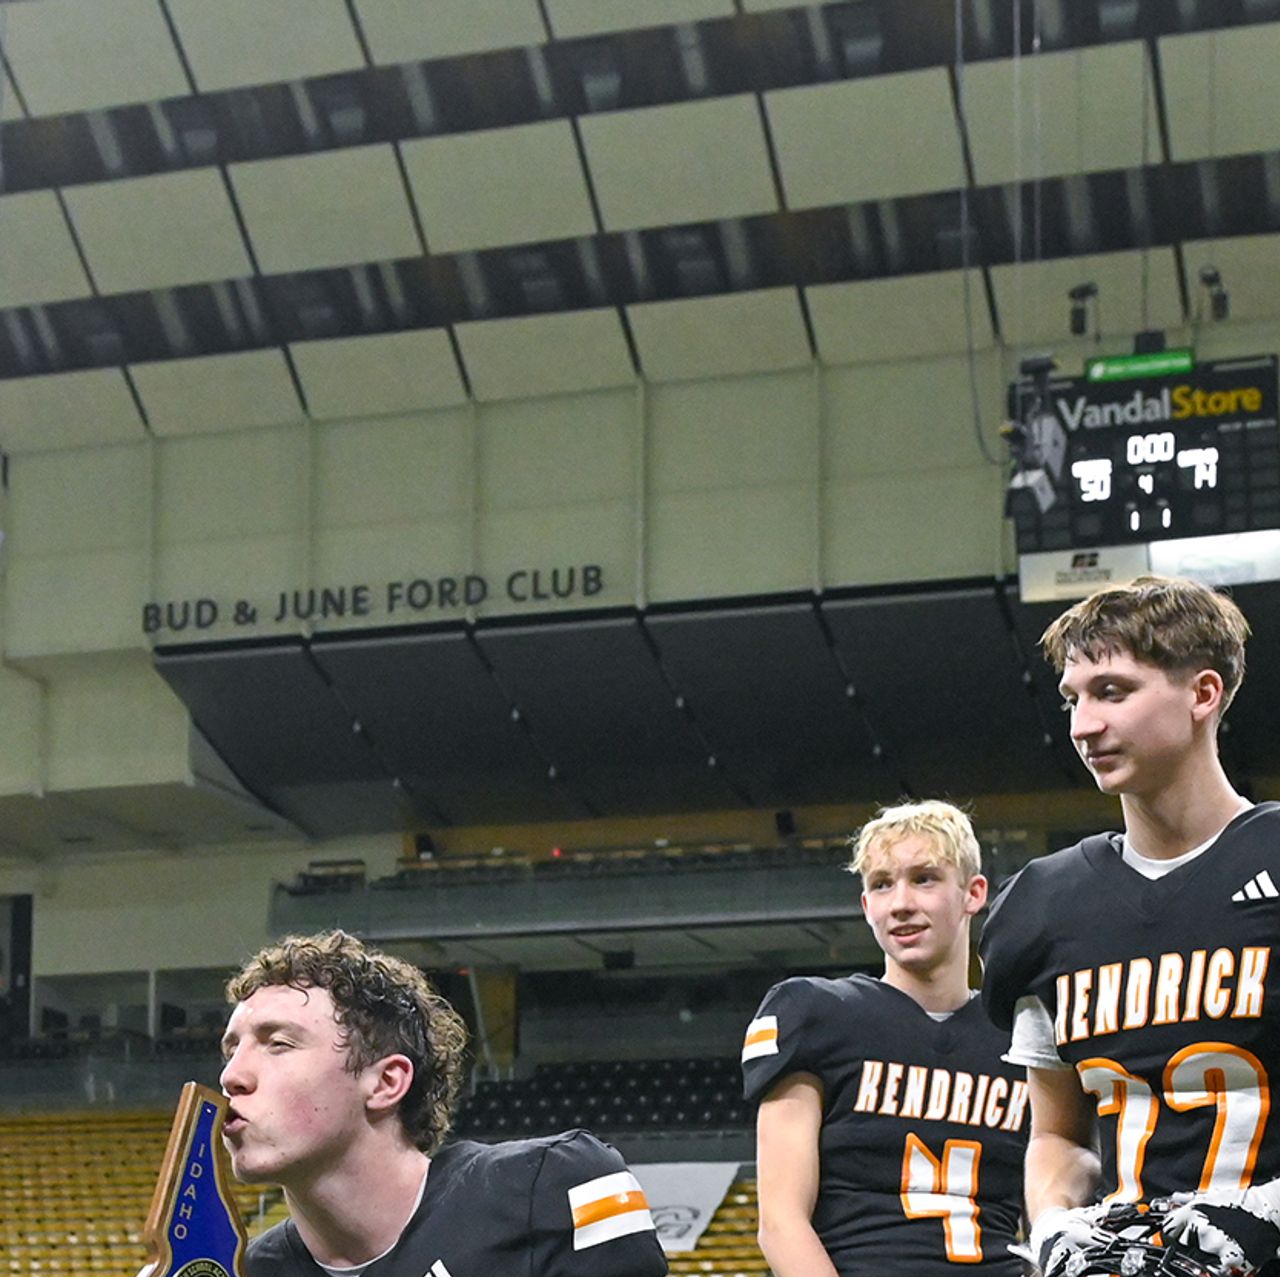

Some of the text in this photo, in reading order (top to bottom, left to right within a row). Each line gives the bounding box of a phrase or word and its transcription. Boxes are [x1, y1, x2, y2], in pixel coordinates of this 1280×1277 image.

[142, 564, 604, 633] BUD & JUNE FORD CLUB
[853, 1060, 1028, 1132] KENDRICK
[173, 1142, 206, 1241] IDAHO
[900, 1132, 983, 1263] 4
